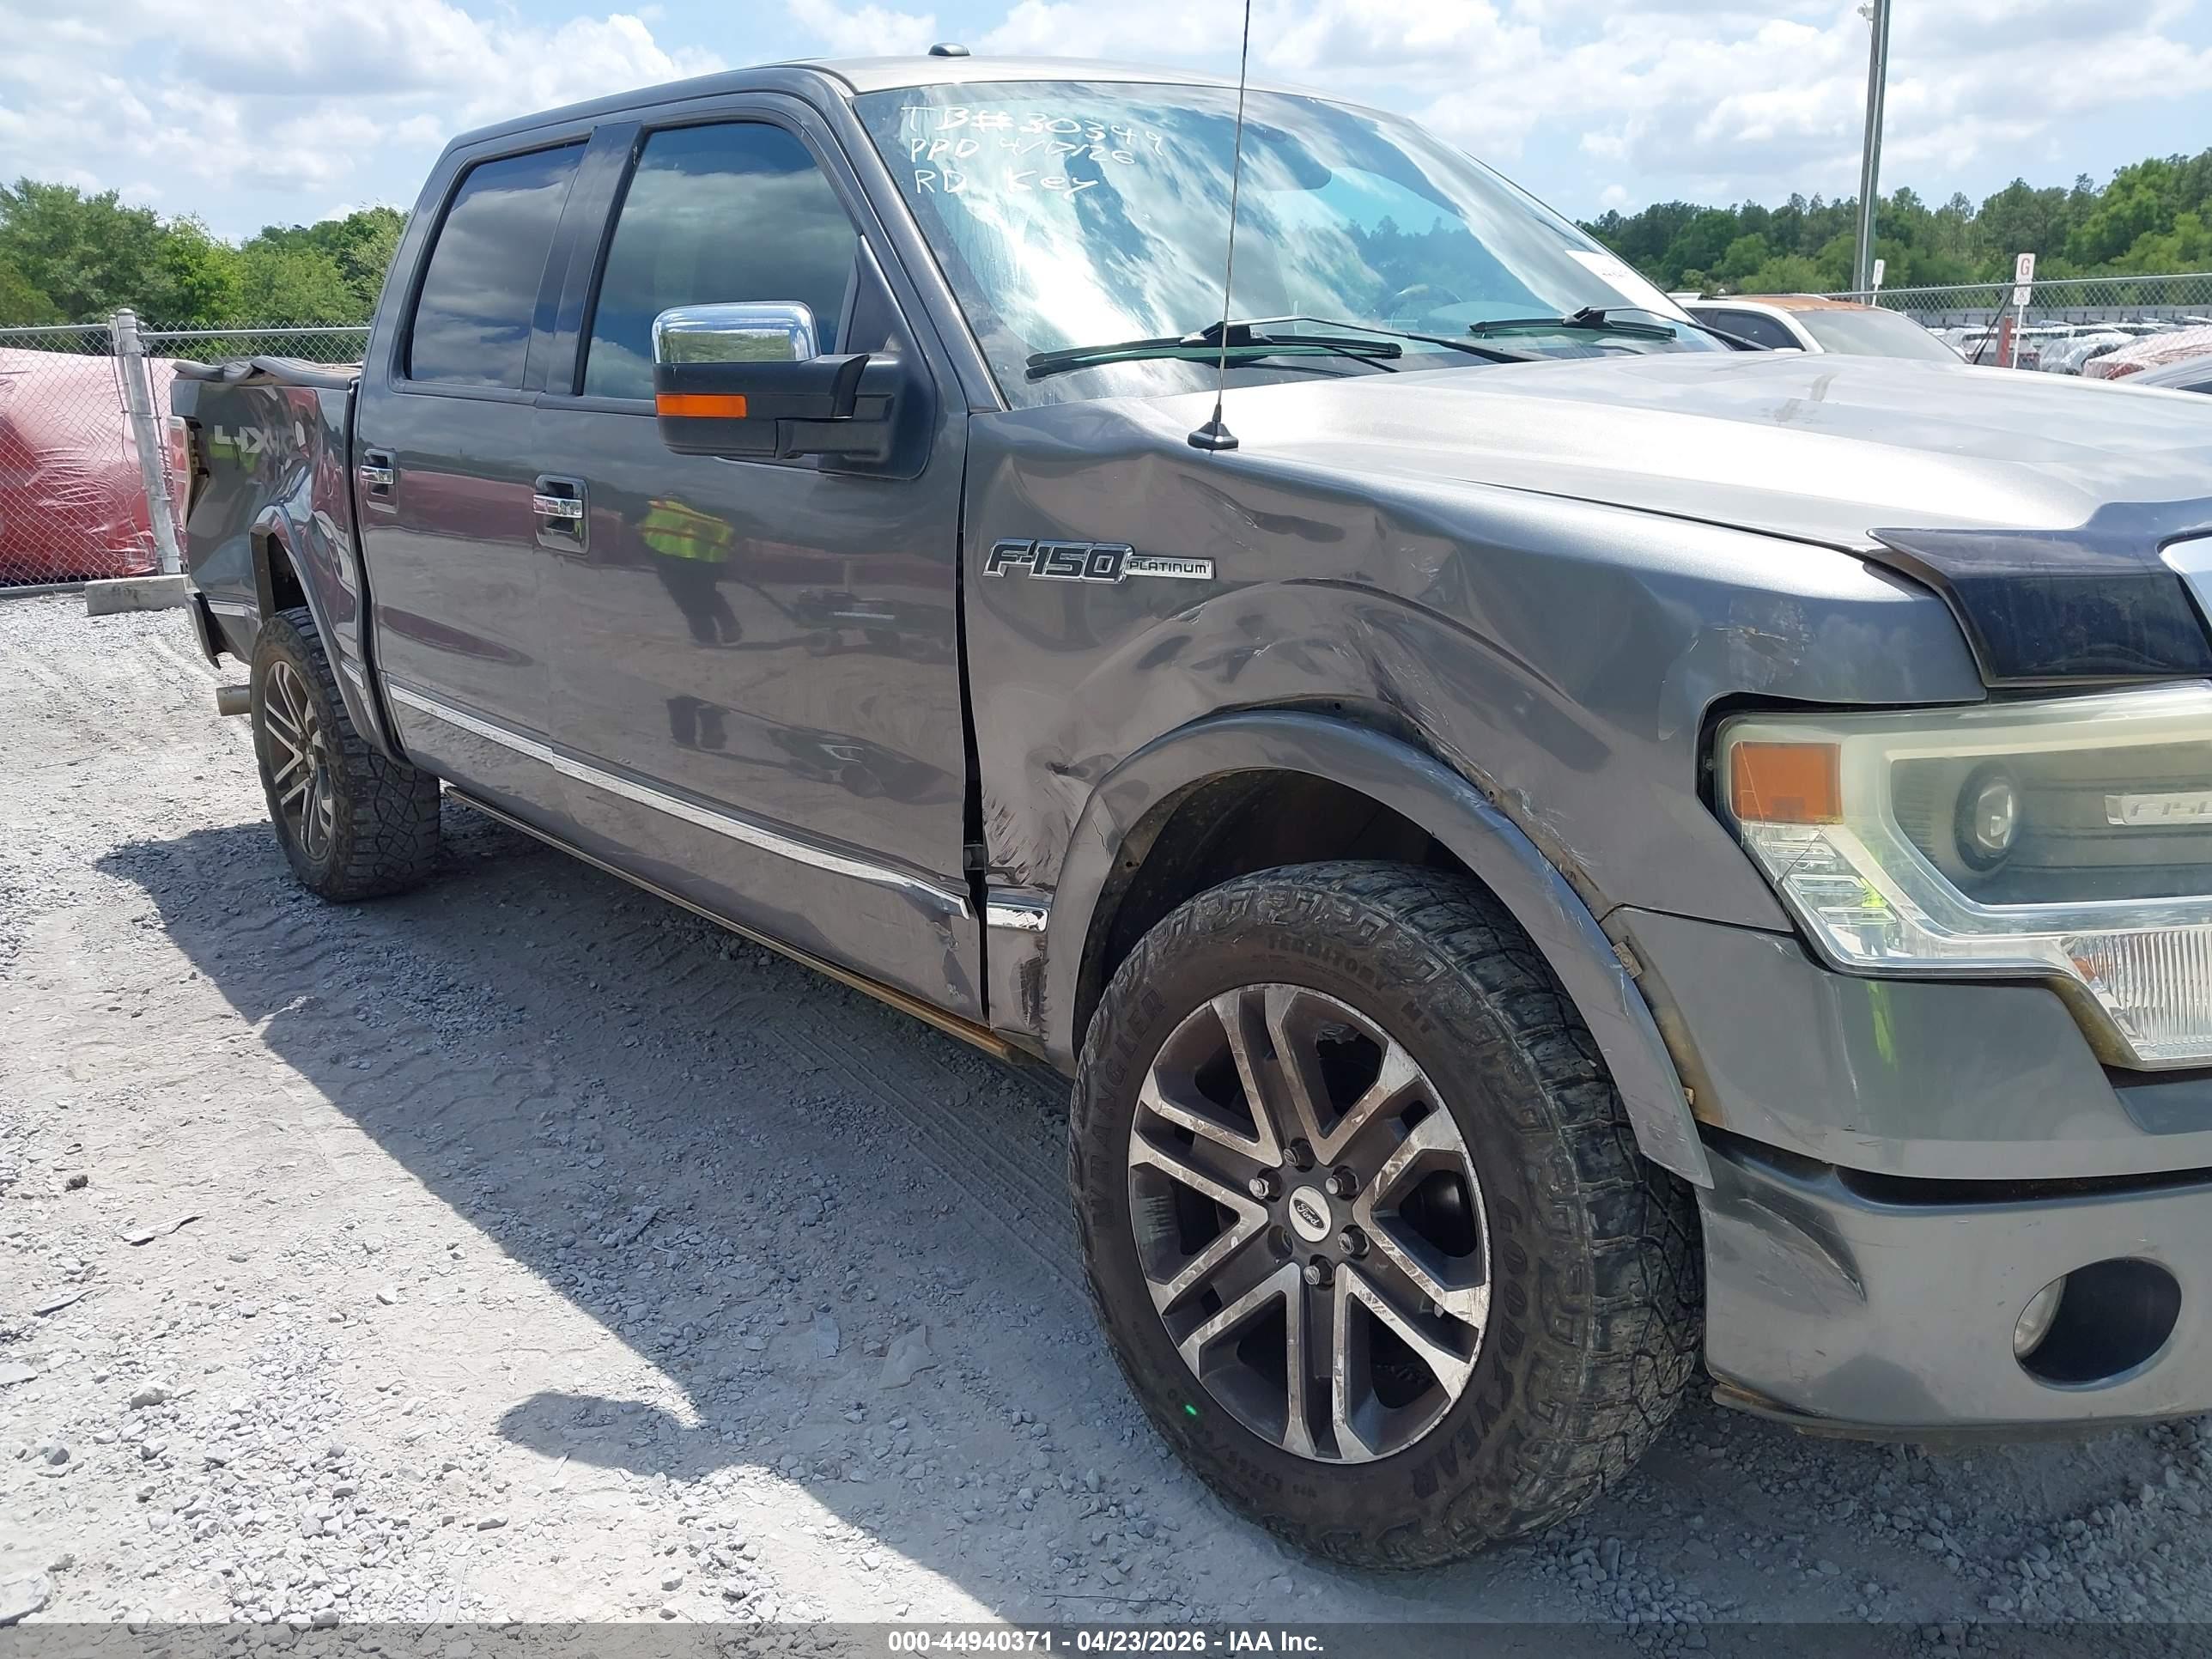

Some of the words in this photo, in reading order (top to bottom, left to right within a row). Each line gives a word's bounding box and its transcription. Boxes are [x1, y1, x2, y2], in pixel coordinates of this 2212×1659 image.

[911, 137, 979, 163] PPD
[915, 169, 967, 193] RD
[1006, 166, 1099, 199] Key
[2020, 258, 2030, 276] G
[982, 538, 1134, 584] F-150
[1128, 561, 1206, 574] PLATINUM
[1090, 988, 1167, 1228] WRANGLER
[1297, 1203, 1321, 1226] Ford
[1411, 1194, 1528, 1499] GOODYEAR
